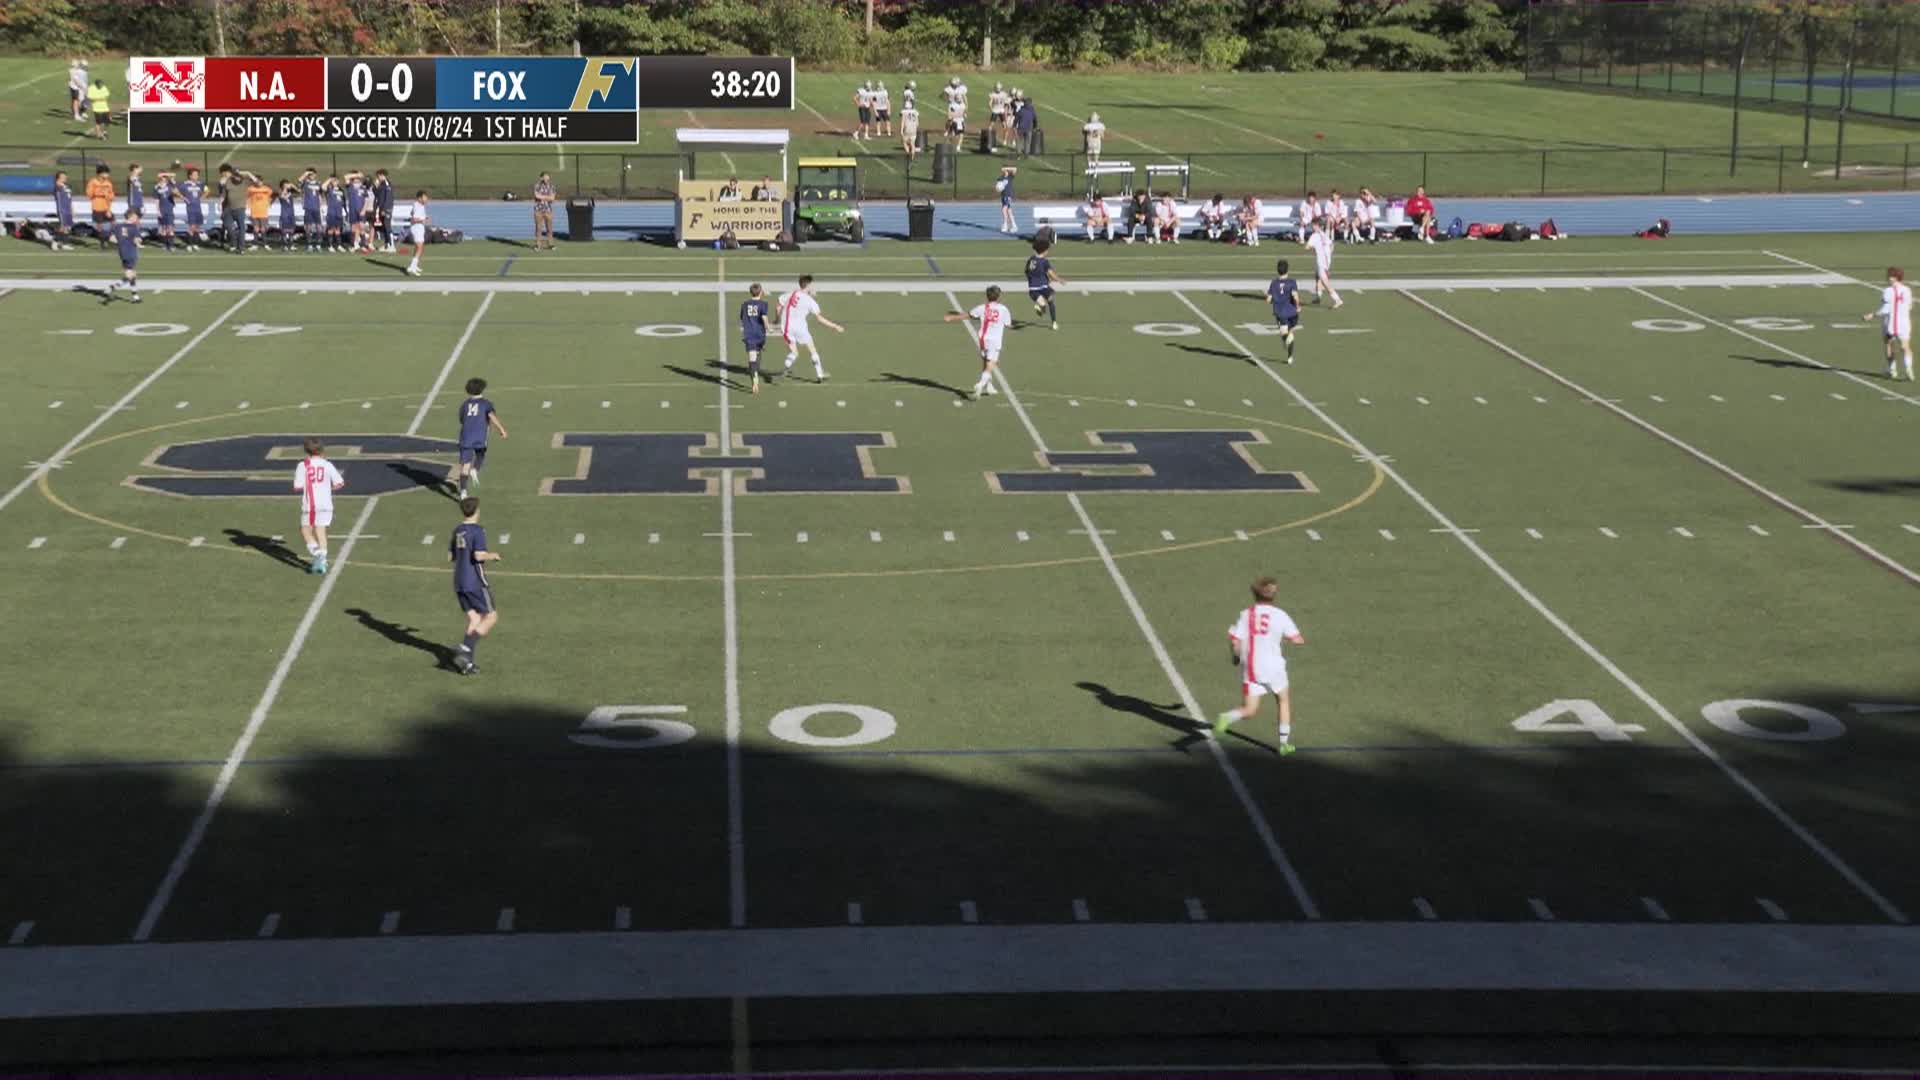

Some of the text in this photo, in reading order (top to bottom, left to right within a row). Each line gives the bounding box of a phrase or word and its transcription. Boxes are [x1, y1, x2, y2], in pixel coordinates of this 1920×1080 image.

[689, 213, 703, 228] F
[711, 221, 781, 231] WARRIORS
[466, 404, 478, 416] 14
[307, 466, 325, 483] 20
